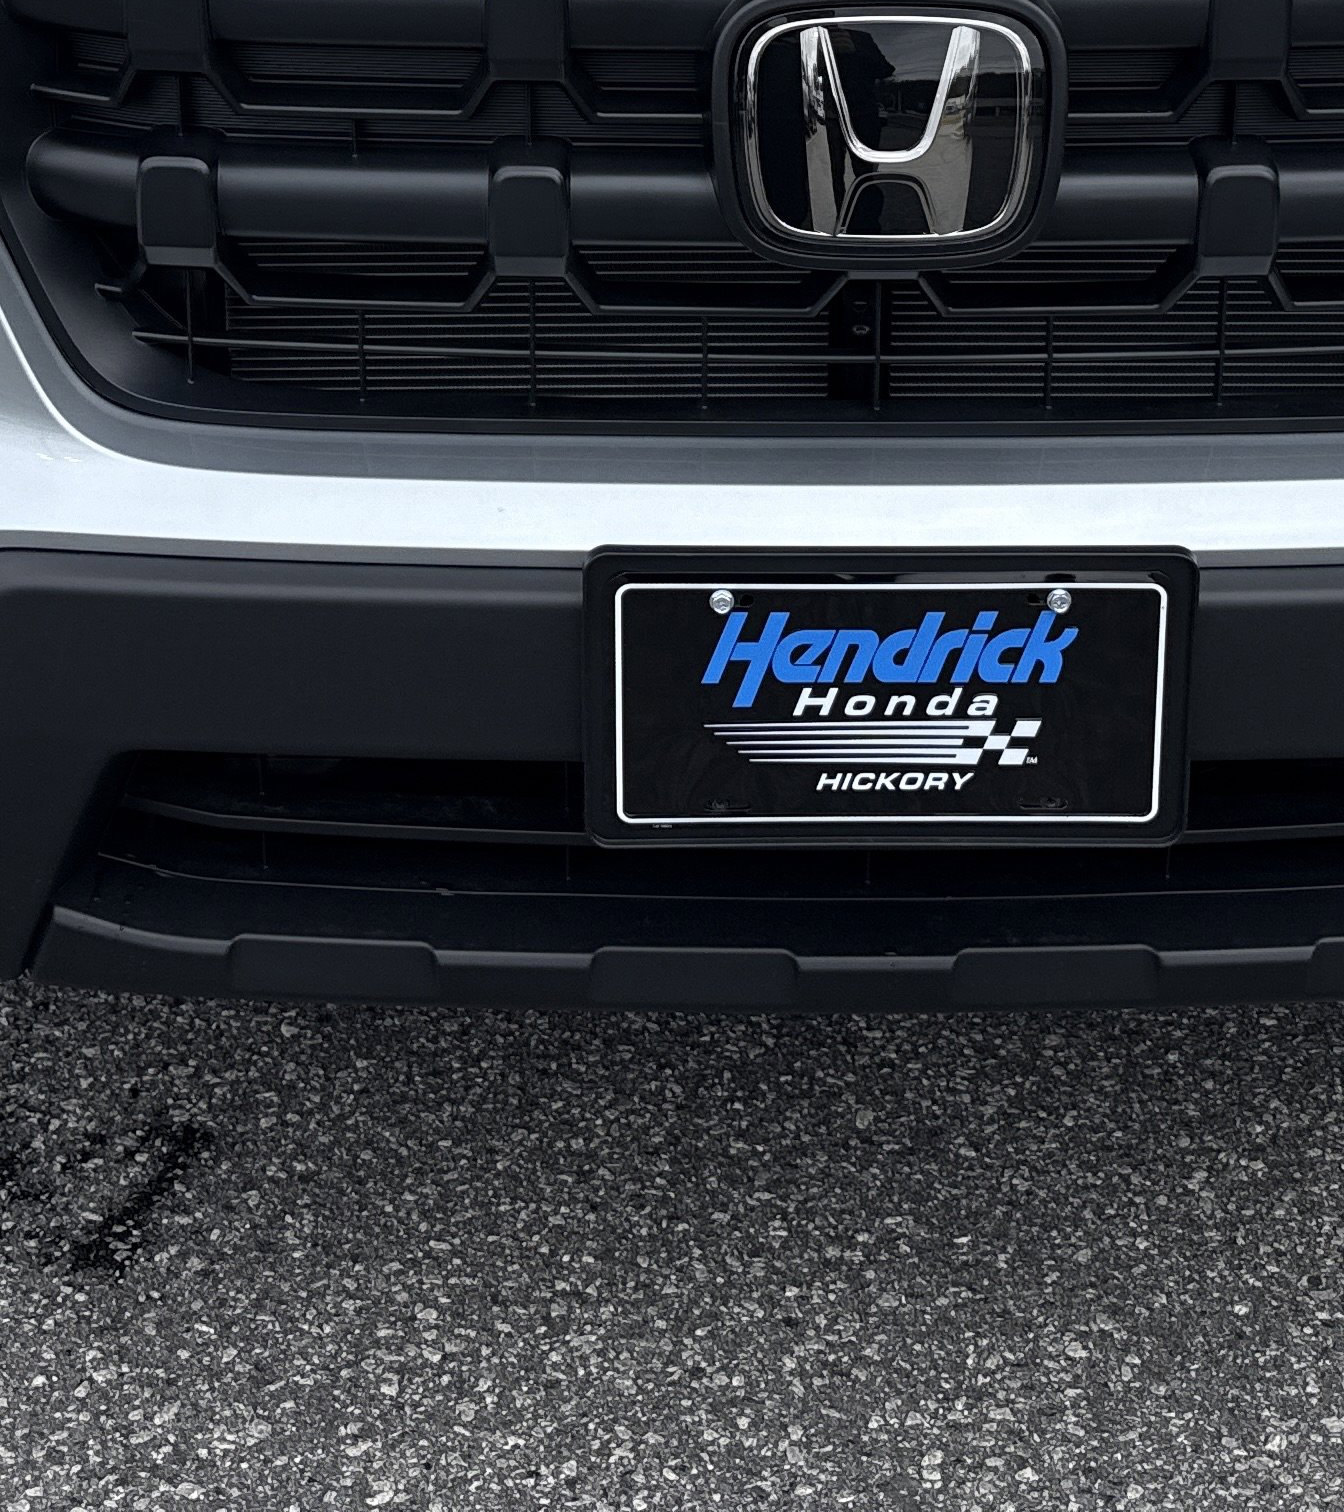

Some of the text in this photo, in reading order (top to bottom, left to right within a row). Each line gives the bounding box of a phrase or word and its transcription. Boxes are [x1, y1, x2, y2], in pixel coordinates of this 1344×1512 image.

[701, 611, 1079, 707] Hendrick
[792, 687, 999, 717] Honda
[816, 771, 975, 791] HICKORY
